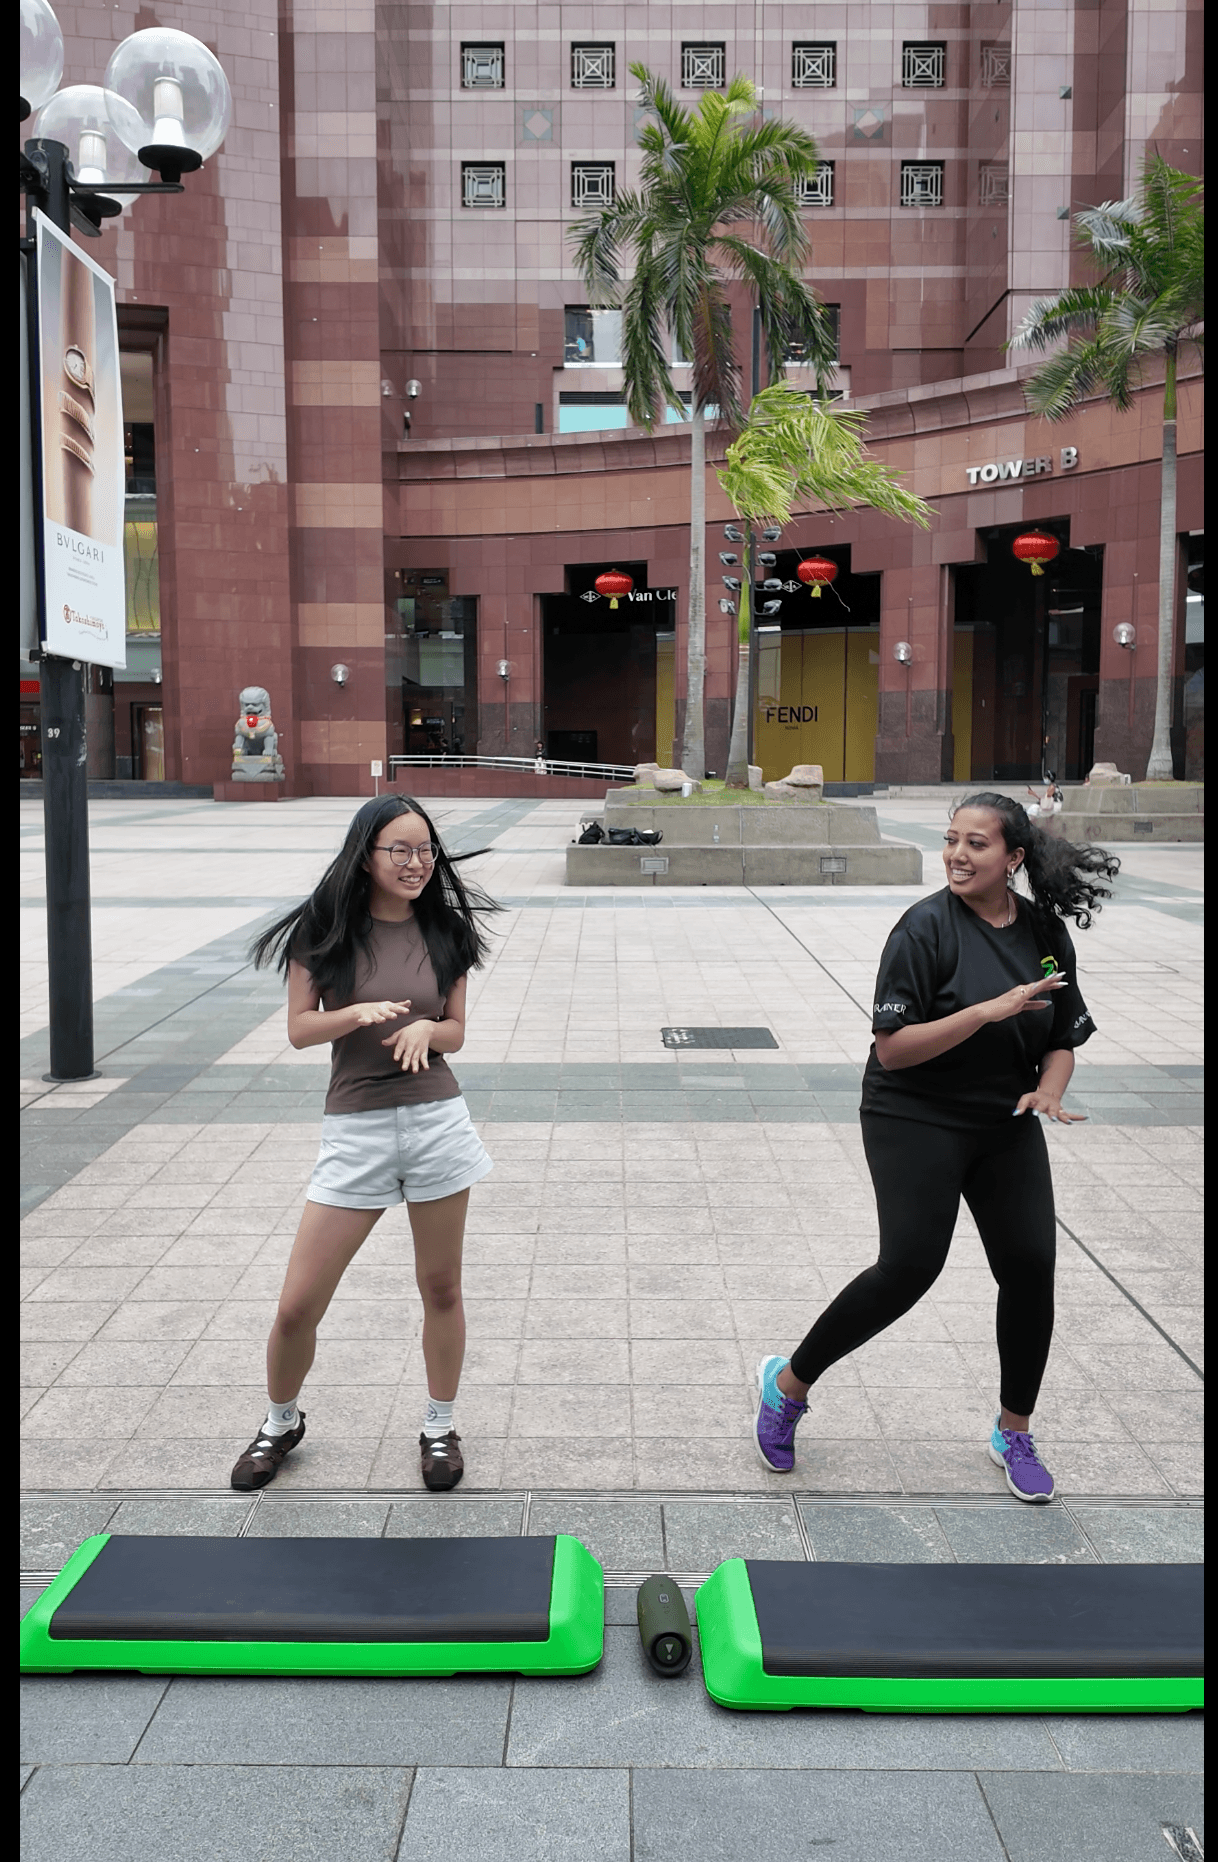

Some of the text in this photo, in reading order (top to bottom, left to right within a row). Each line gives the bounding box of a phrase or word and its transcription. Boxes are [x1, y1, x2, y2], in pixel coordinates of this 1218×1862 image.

[966, 446, 1078, 485] TOWER B
[57, 532, 104, 563] BVLGARI
[628, 588, 653, 602] Van
[766, 705, 818, 723] FENDI
